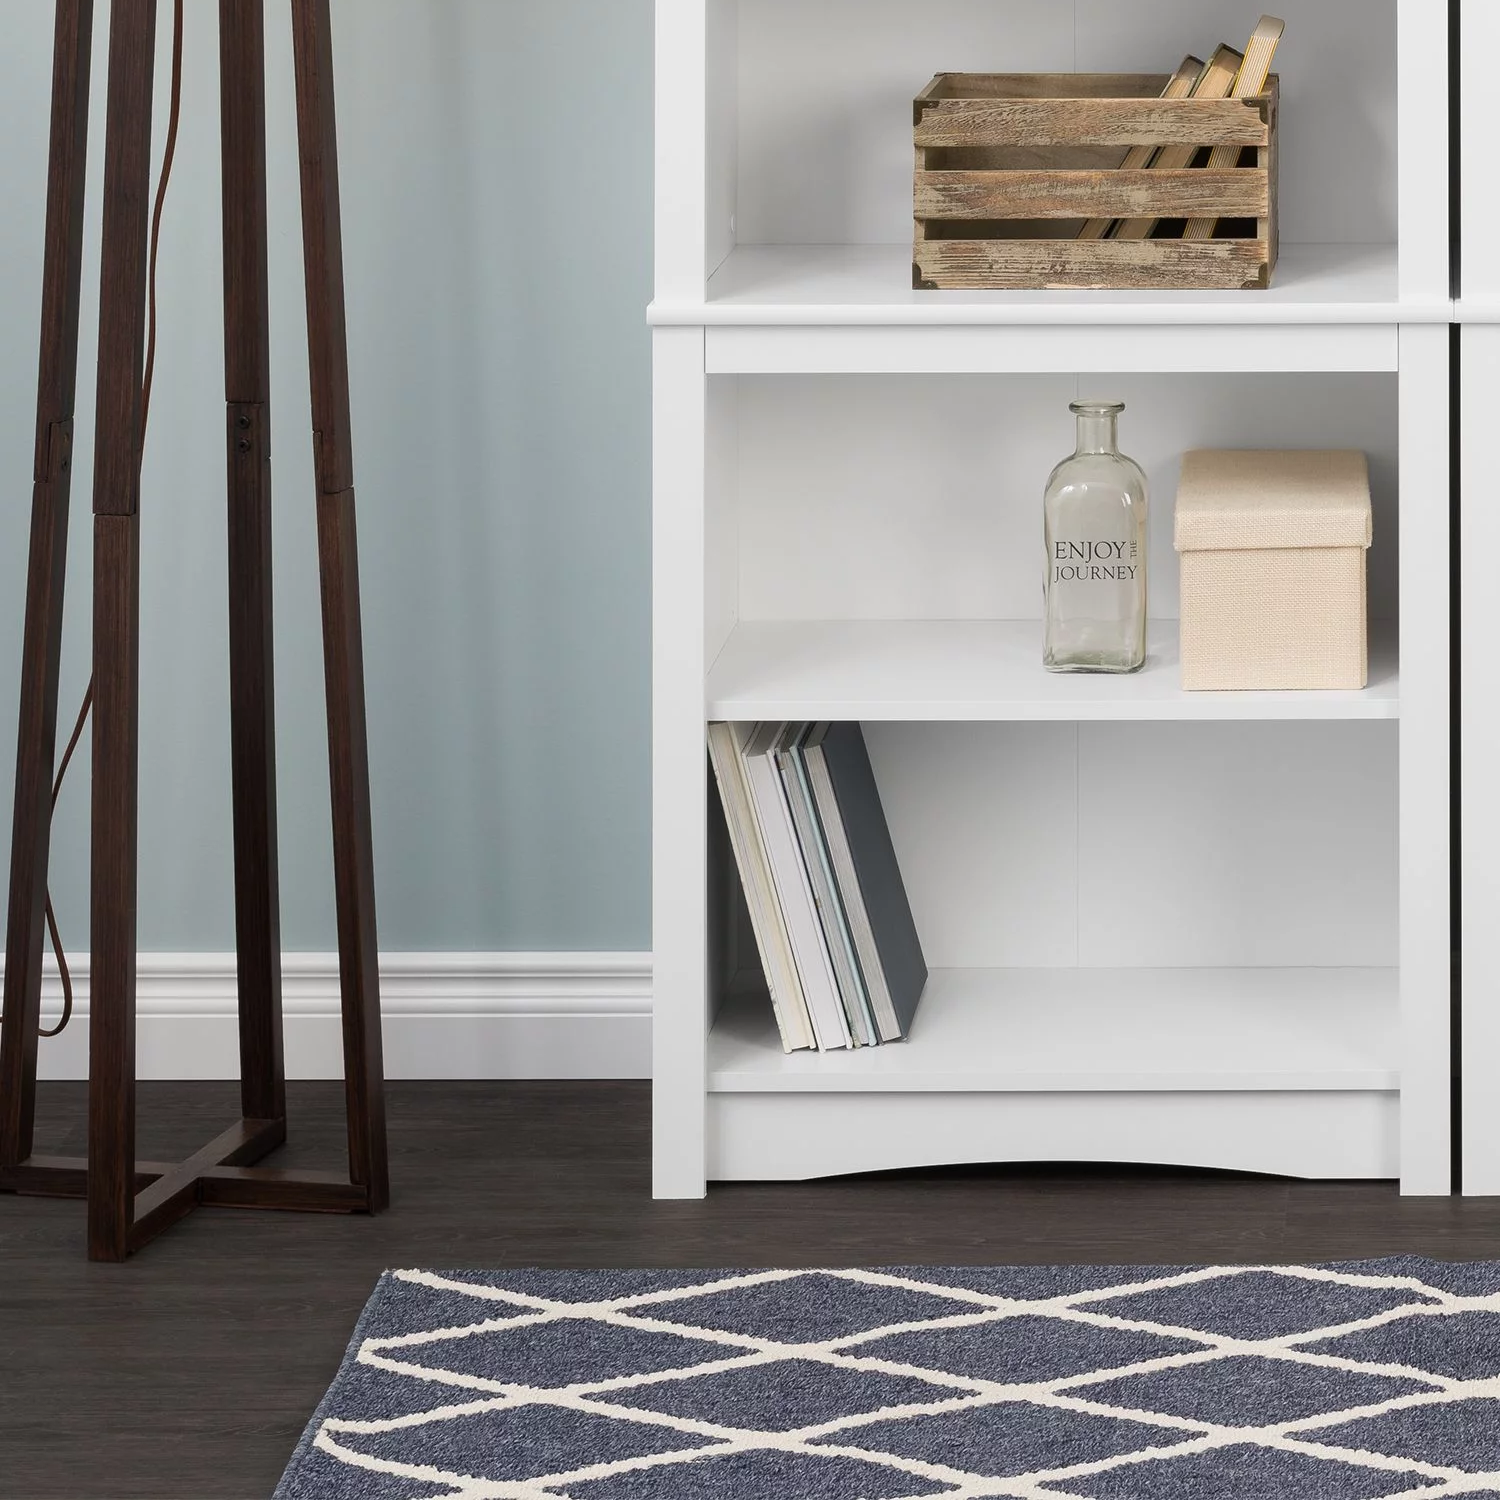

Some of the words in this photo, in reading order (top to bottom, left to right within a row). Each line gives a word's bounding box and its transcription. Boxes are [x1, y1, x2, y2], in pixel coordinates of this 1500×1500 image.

[1055, 541, 1126, 563] ENJOY
[1130, 540, 1138, 559] THE
[1054, 565, 1137, 583] JOURNEY
